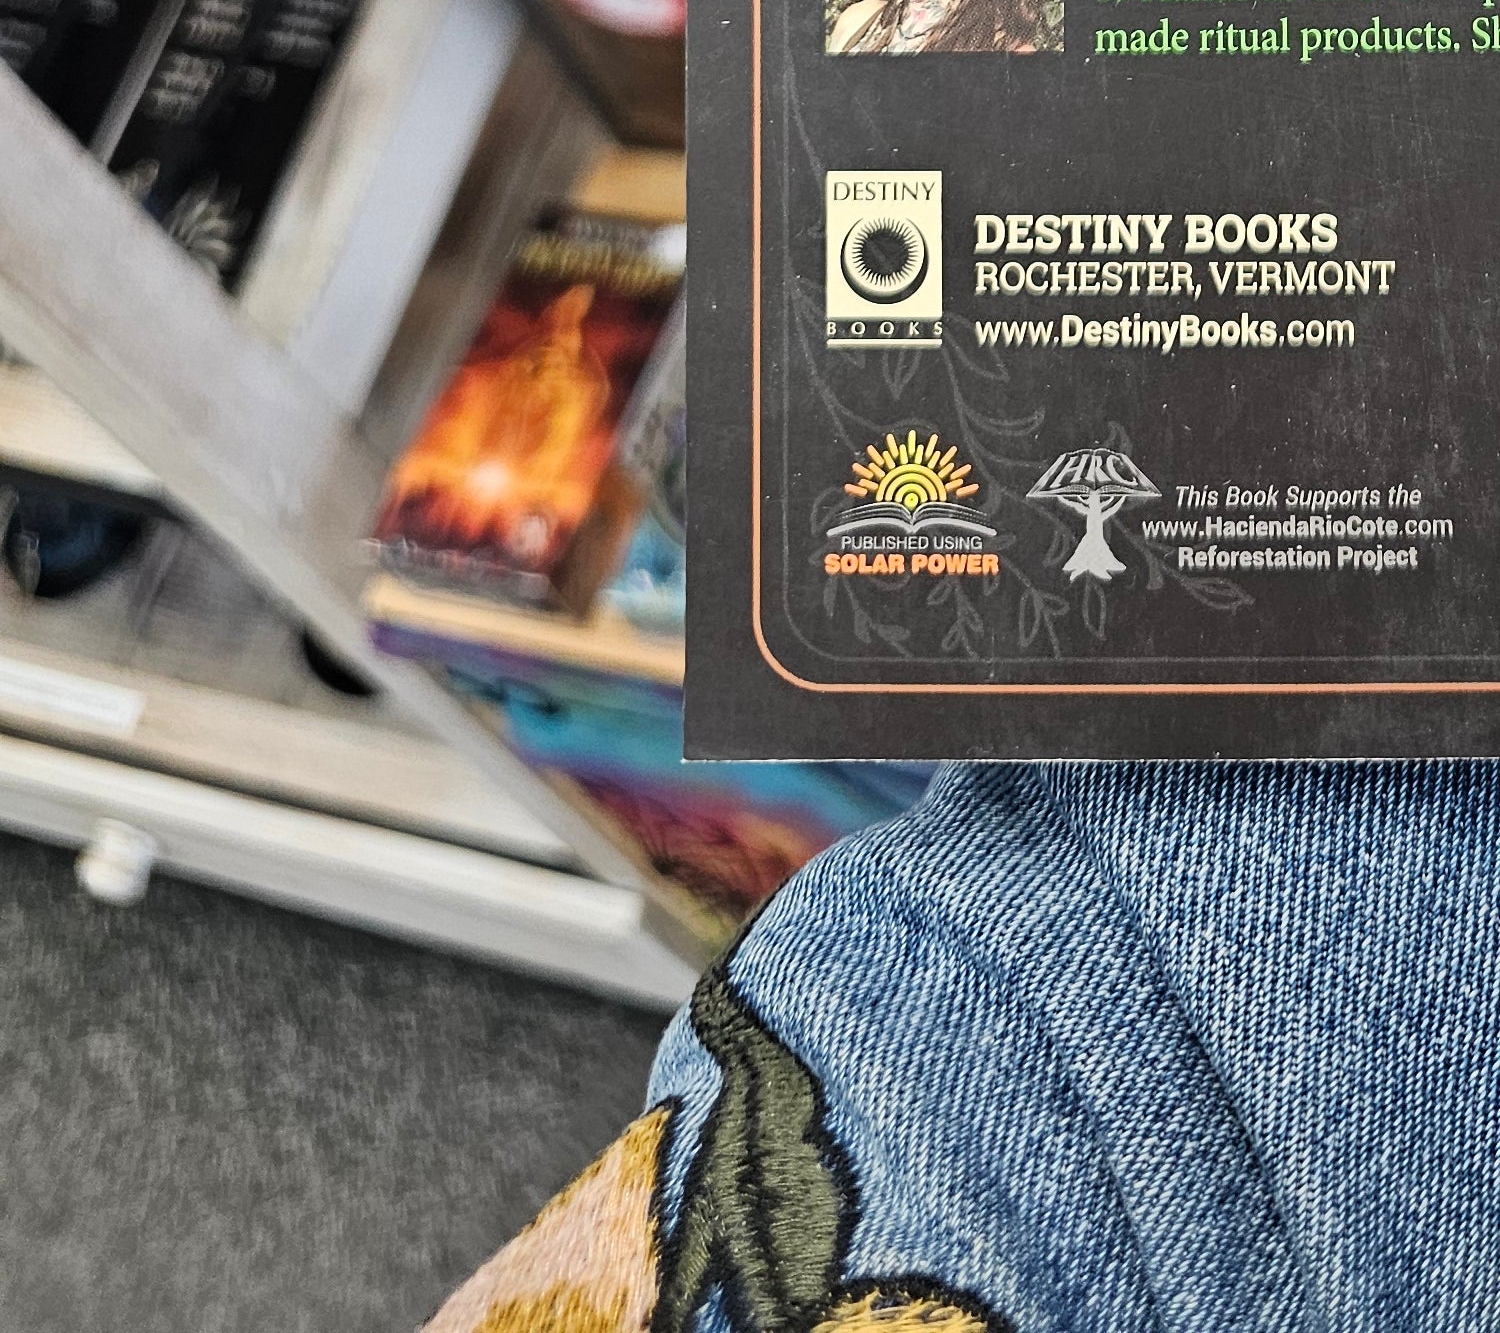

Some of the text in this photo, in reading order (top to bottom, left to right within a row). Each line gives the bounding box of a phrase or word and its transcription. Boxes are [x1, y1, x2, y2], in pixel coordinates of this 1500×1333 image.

[1095, 18, 1189, 55] made
[1199, 17, 1290, 55] ritual
[1300, 16, 1460, 64] products.
[832, 180, 935, 202] DESTINY
[974, 213, 1339, 256] DESTINY BOOKS
[974, 260, 1396, 299] ROCHESTER, VERMONT
[826, 320, 943, 337] BOOKS
[974, 314, 1356, 354] www.DestinyBooks.com
[1175, 483, 1422, 512] This Book Supports the
[1142, 512, 1454, 540] www.HaciendaRioCote.com
[840, 533, 983, 551] PUBLISHED USING
[825, 552, 999, 575] SOLAR POWER
[1177, 544, 1418, 572] Reforestation Project
